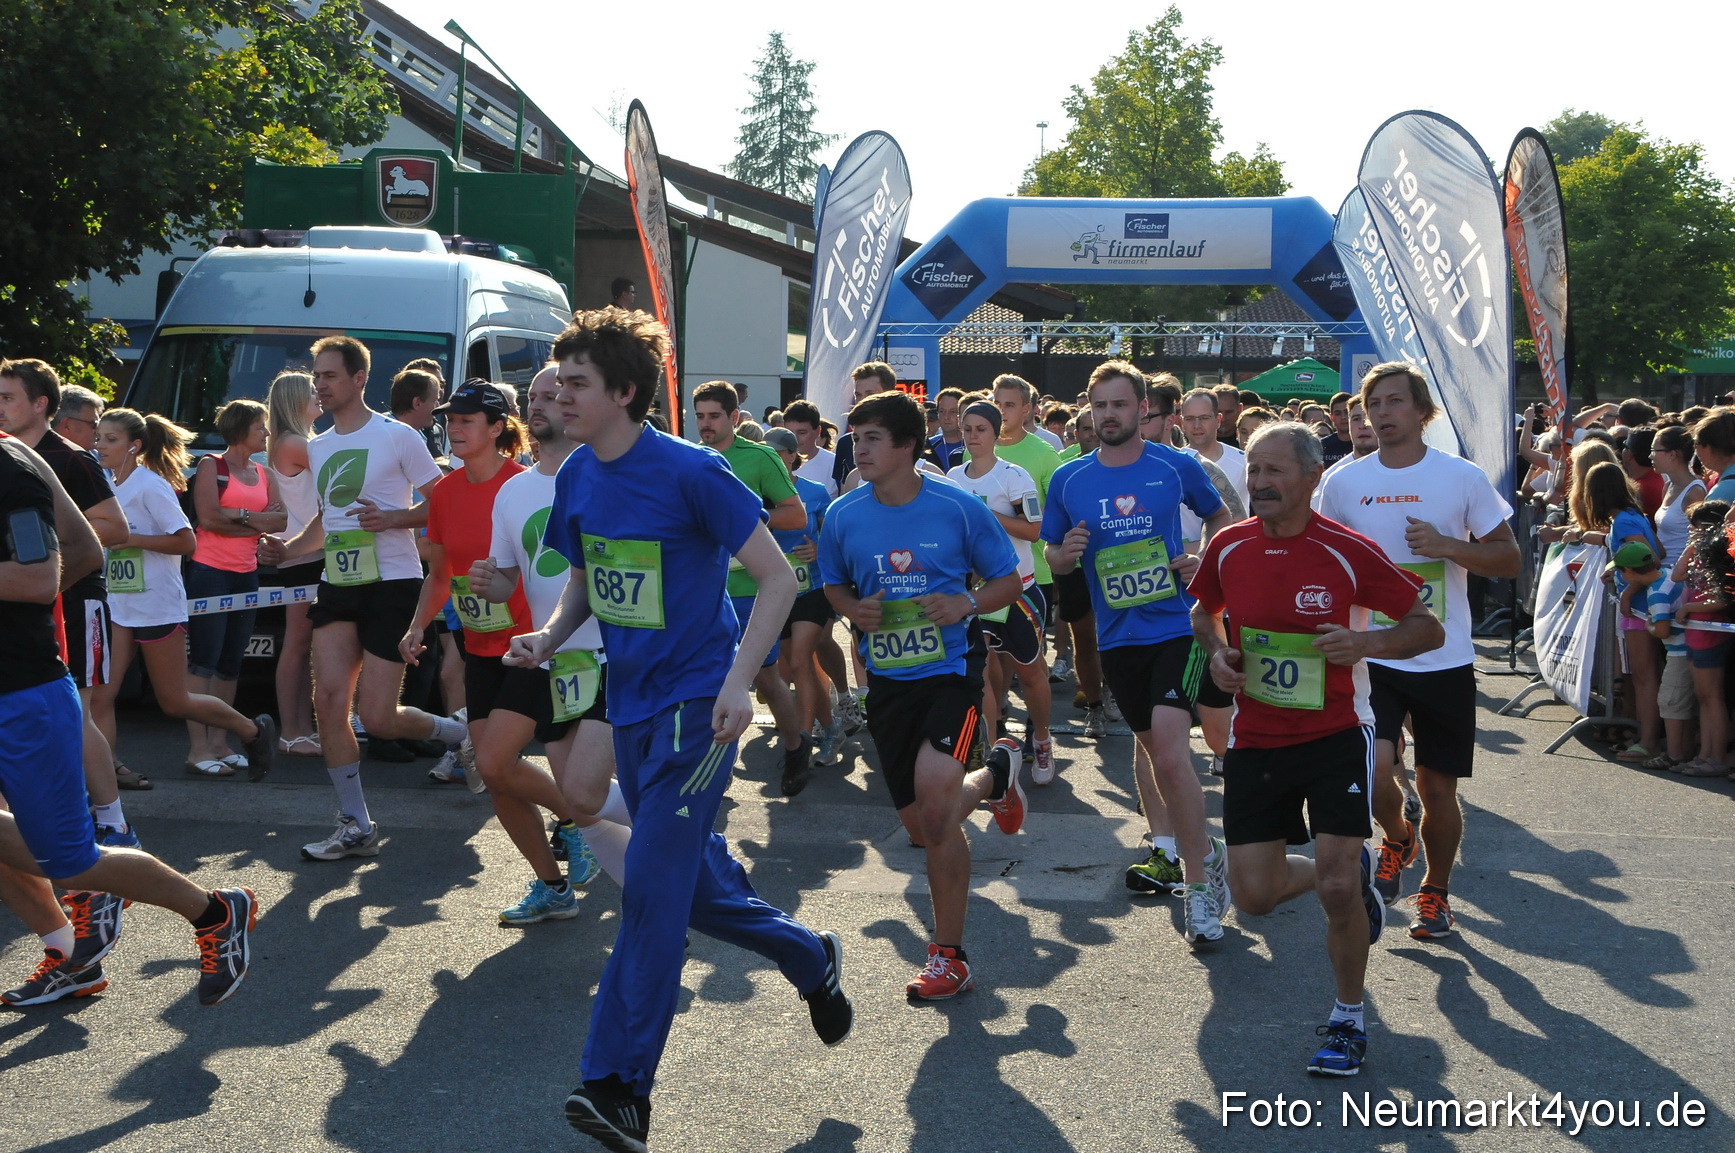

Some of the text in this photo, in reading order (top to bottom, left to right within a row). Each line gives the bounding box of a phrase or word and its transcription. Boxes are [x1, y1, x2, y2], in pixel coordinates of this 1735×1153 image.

[395, 210, 420, 220] 1628
[1133, 222, 1167, 230] Fischer
[837, 167, 891, 322] Fischer
[1108, 239, 1207, 258] firmenlauf
[860, 197, 898, 320] AUTOMOBILE
[921, 271, 974, 283] Fischer
[1098, 498, 1111, 520] I
[1376, 495, 1423, 504] KLEBL
[1100, 514, 1153, 530] camping
[1133, 528, 1152, 536] Berger
[110, 559, 136, 581] 900
[335, 549, 360, 573] 97
[873, 554, 887, 575] I
[593, 566, 646, 605] 687
[878, 572, 927, 586] camping
[1106, 565, 1172, 601] 5052
[872, 626, 939, 660] 5045
[1260, 657, 1299, 689] 20
[555, 674, 580, 704] 91
